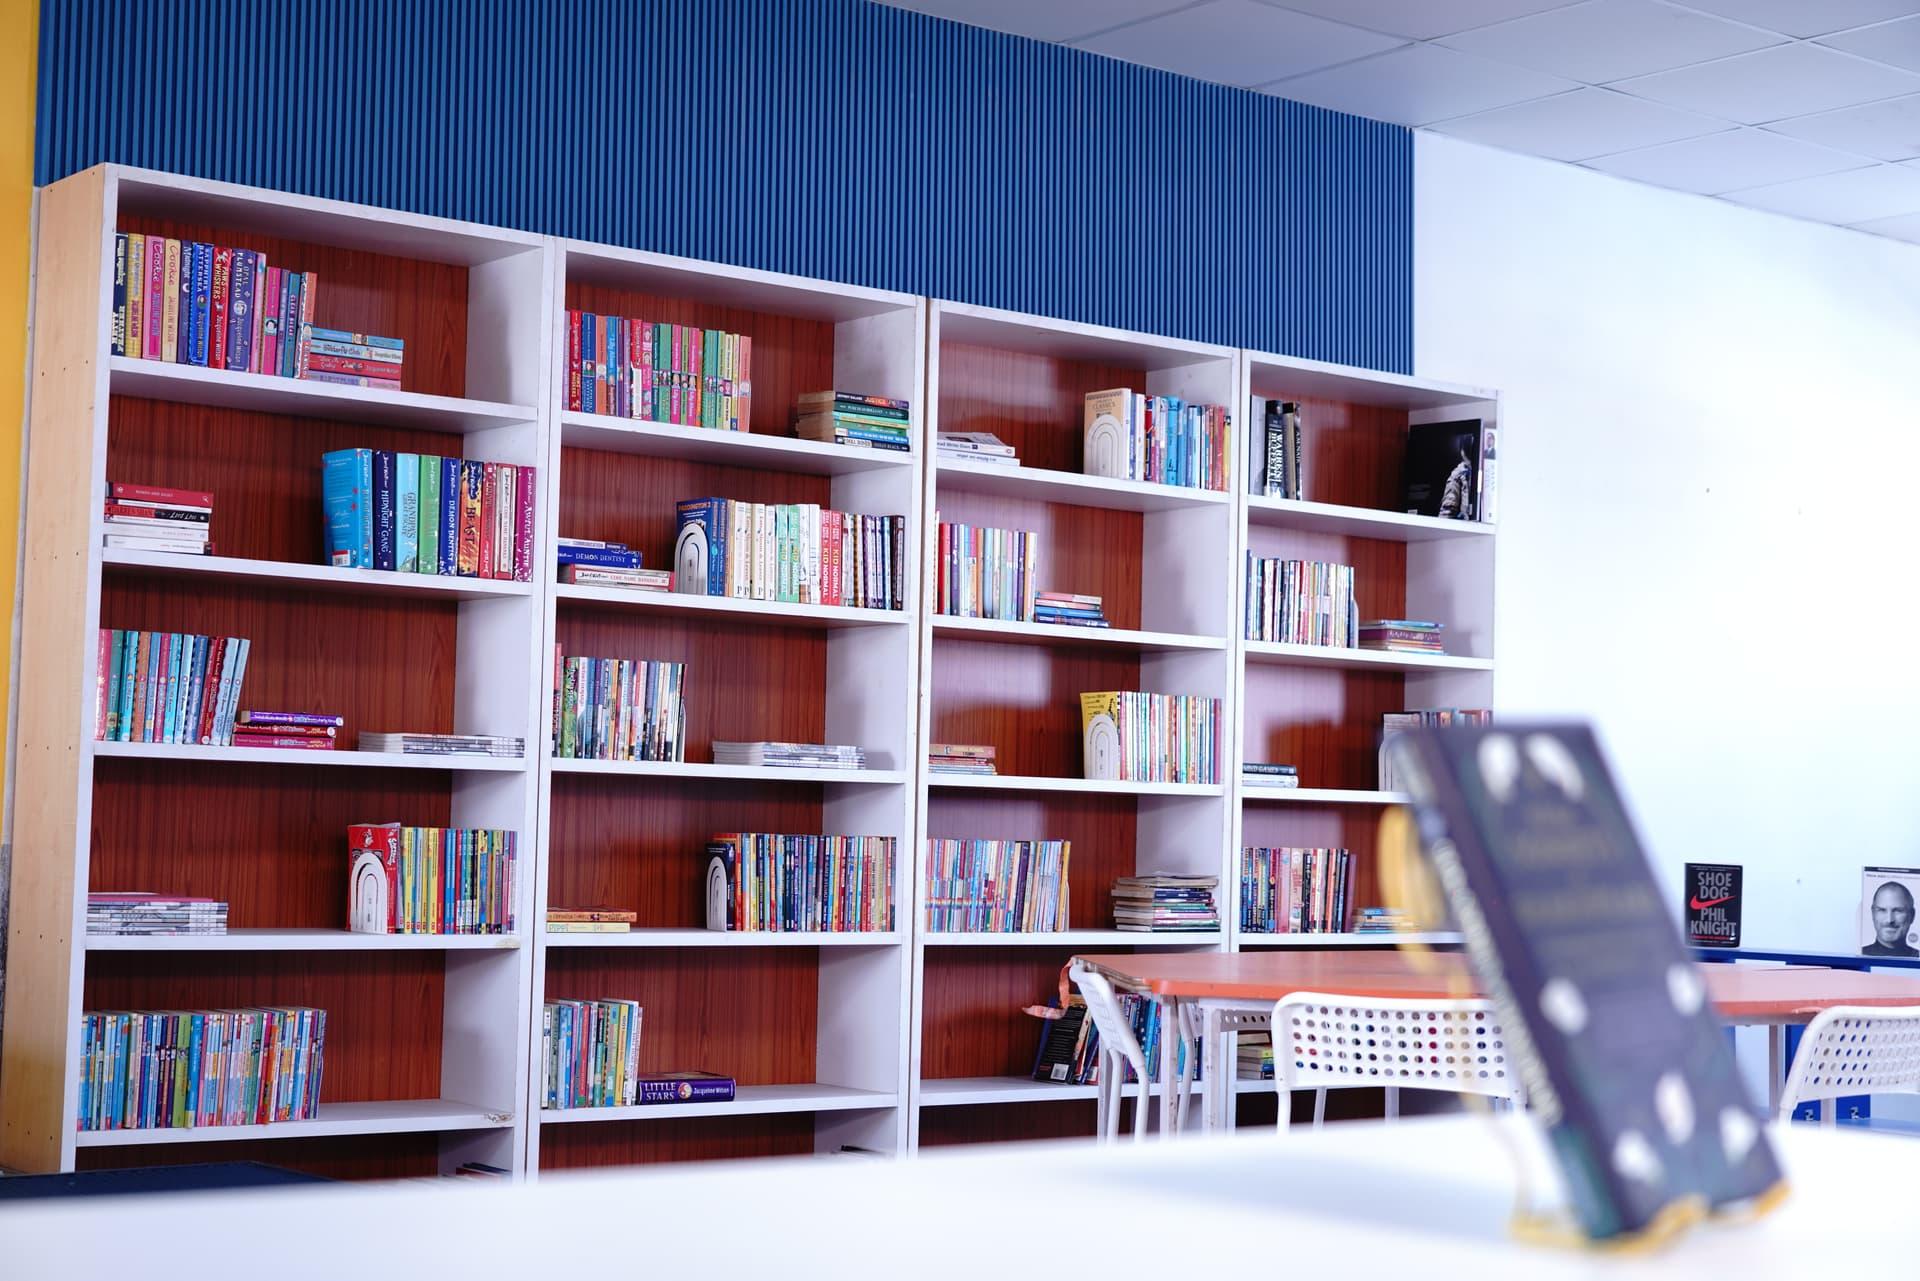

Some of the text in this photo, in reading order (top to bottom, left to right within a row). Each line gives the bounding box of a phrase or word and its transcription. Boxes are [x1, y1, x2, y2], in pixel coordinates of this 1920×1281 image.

[152, 243, 162, 282] Cookie
[168, 244, 179, 286] Cookie
[182, 246, 192, 279] Midnight
[234, 252, 243, 298] PLUMSTEAD
[242, 266, 250, 285] OPAL
[213, 262, 222, 300] WHISKERS
[117, 305, 125, 352] FEATHER
[214, 314, 224, 343] Jacqueline
[380, 490, 390, 553] MIDNIGHT GANG
[464, 507, 476, 545] BEAST
[523, 506, 533, 568] AWFUL AUNTIE
[447, 530, 455, 561] DENTIST
[575, 553, 626, 563] DEMON DENTIST
[832, 565, 840, 599] NORMAL
[1697, 872, 1732, 887] SHOE
[1700, 886, 1729, 900] DOG
[1690, 920, 1737, 936] KNIGHT
[1701, 907, 1728, 922] PHIL
[644, 1082, 676, 1092] LITTLE
[646, 1091, 674, 1101] STARS
[693, 1087, 716, 1096] Jacqueline
